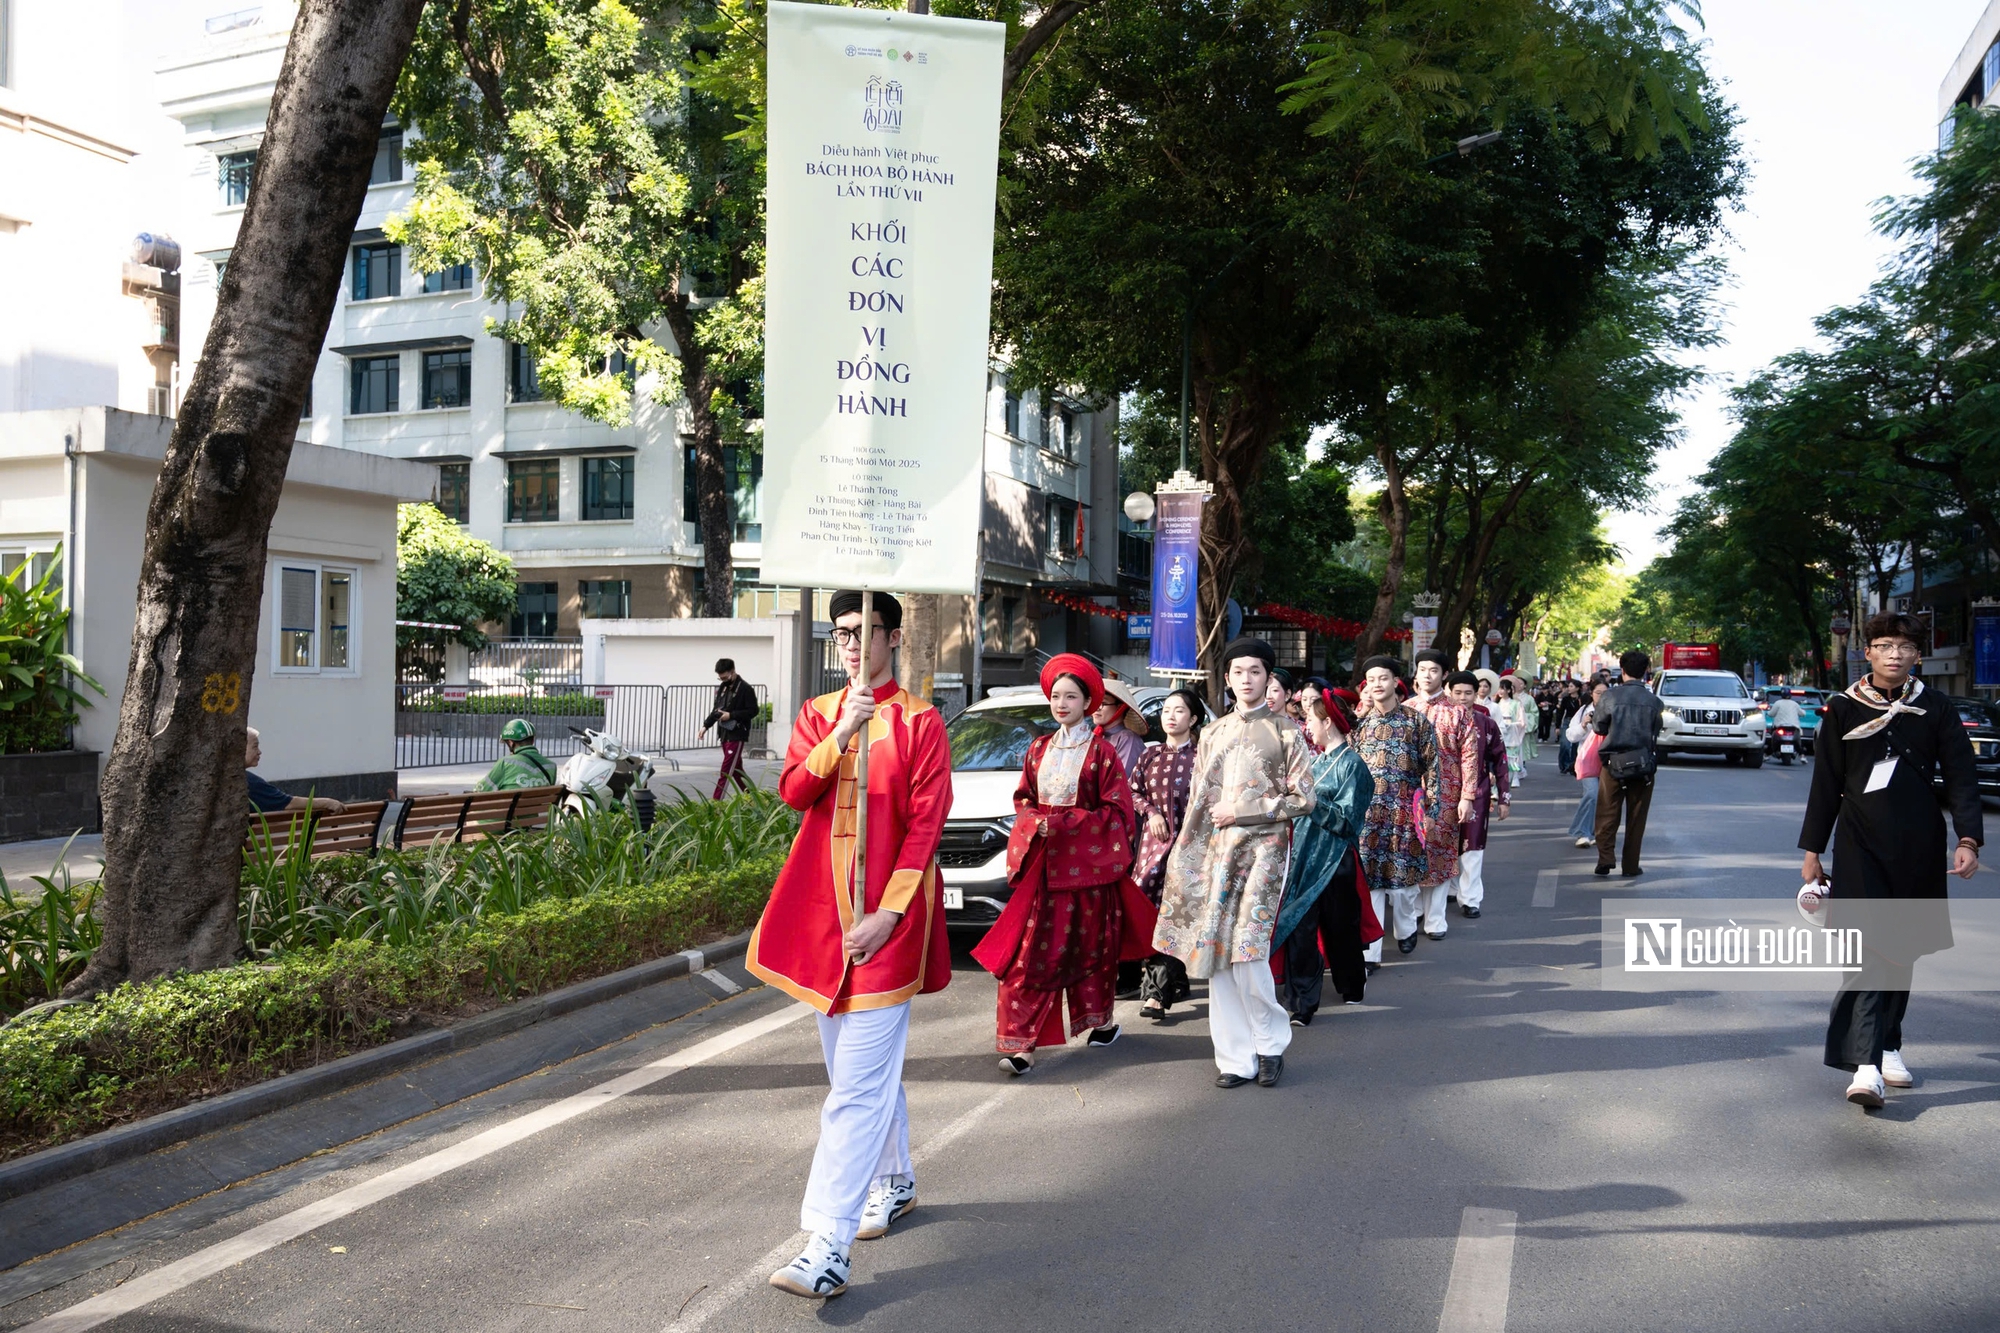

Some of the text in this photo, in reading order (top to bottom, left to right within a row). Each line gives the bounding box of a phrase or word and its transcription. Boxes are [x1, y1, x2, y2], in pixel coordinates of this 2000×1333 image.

[822, 144, 940, 165] Diễu hành Việt phục
[806, 161, 954, 186] BÁCH HOA BỘ HÀNH
[837, 181, 922, 202] LẦN THỨ VII
[851, 219, 907, 244] KHỐI
[851, 252, 904, 279] CÁC
[848, 290, 904, 314] ĐƠN
[862, 326, 886, 351] VỊ
[837, 354, 911, 384] ĐỒNG
[837, 391, 907, 417] HÀNH
[820, 455, 828, 463] 15
[879, 458, 896, 467] Một
[898, 459, 921, 469] 2025
[857, 498, 875, 508] Kiệt
[884, 500, 906, 510] Hàng
[842, 522, 861, 532] Khay
